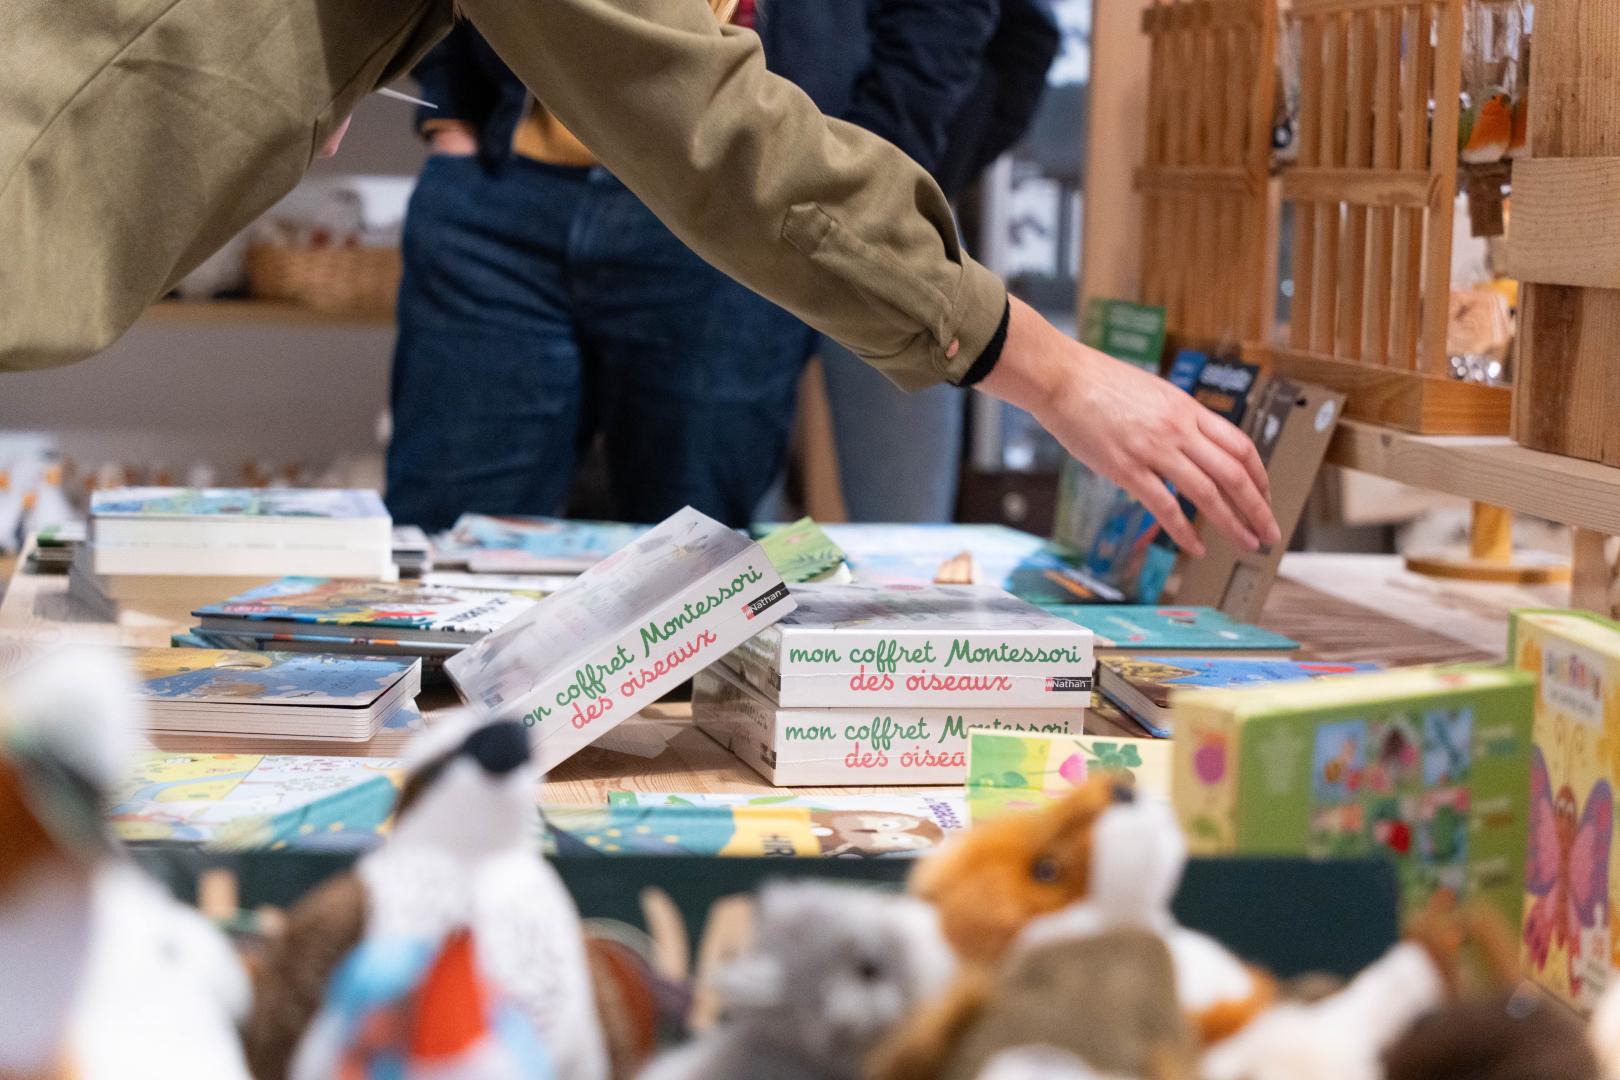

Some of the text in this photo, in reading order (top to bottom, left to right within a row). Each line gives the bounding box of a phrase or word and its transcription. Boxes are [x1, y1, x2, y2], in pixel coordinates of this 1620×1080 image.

[749, 590, 782, 613] Nathan
[522, 565, 763, 730] on coffret Montessori
[789, 638, 1082, 674] mon coffret Montessori
[571, 629, 717, 729] des oiseaux
[849, 664, 1013, 693] des oiseaux
[1052, 679, 1086, 688] Nathan
[785, 715, 1071, 751] mon coffret Mtssori
[843, 742, 966, 769] des oisea
